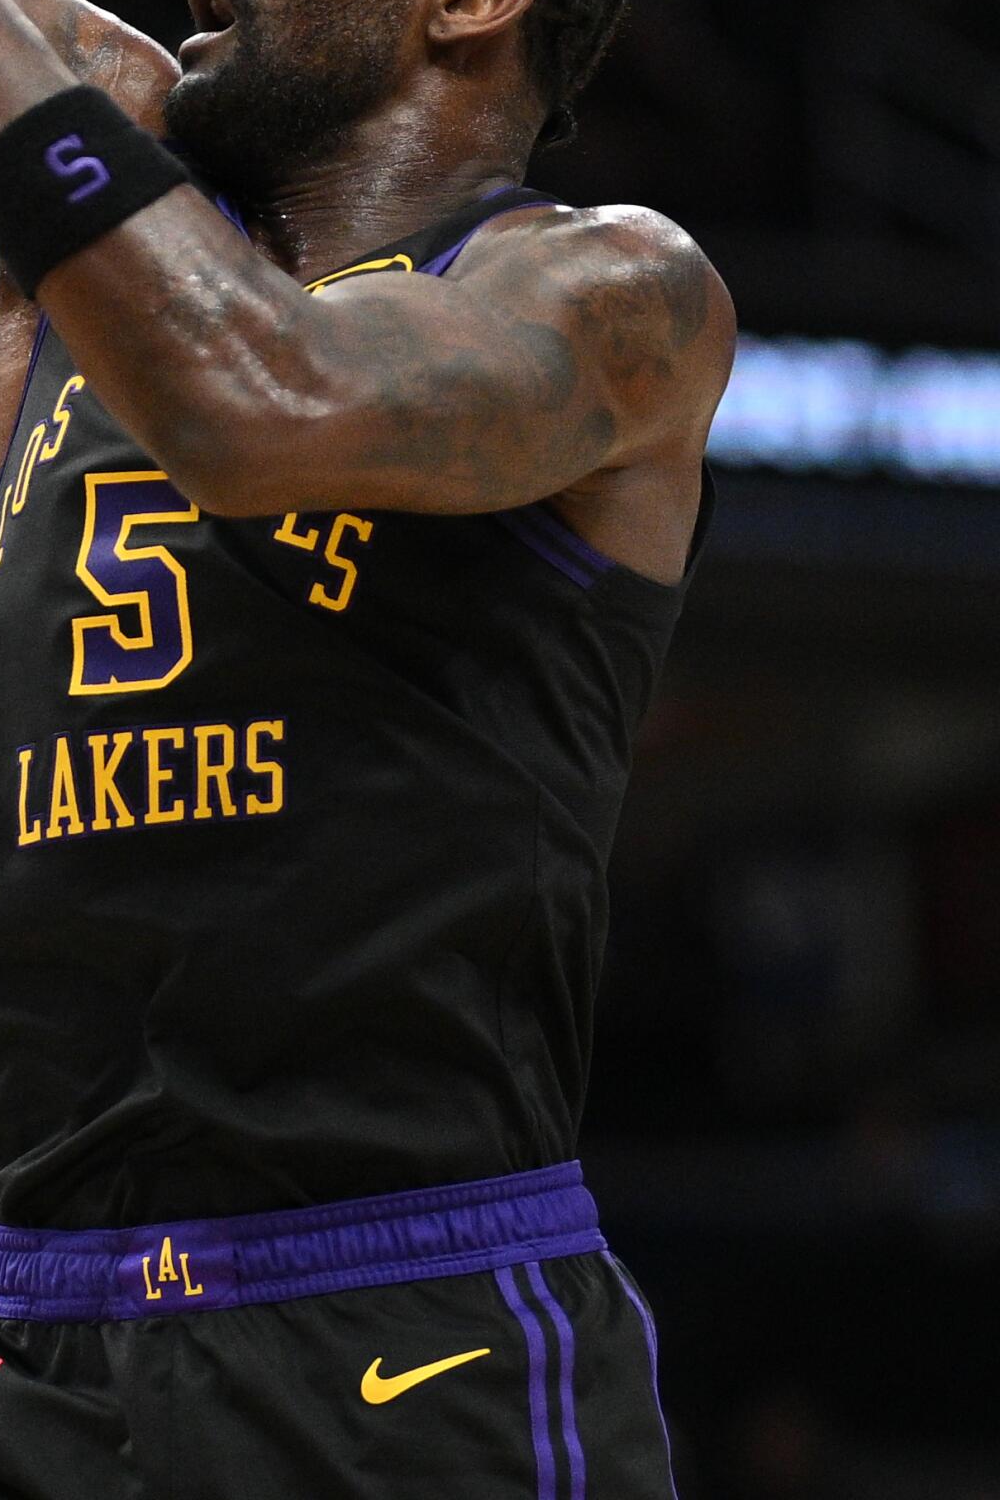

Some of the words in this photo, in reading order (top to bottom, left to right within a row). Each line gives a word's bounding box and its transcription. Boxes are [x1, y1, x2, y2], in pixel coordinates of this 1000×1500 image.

[68, 470, 200, 696] 5
[16, 717, 286, 847] LAKERS
[142, 1236, 203, 1300] LAL
